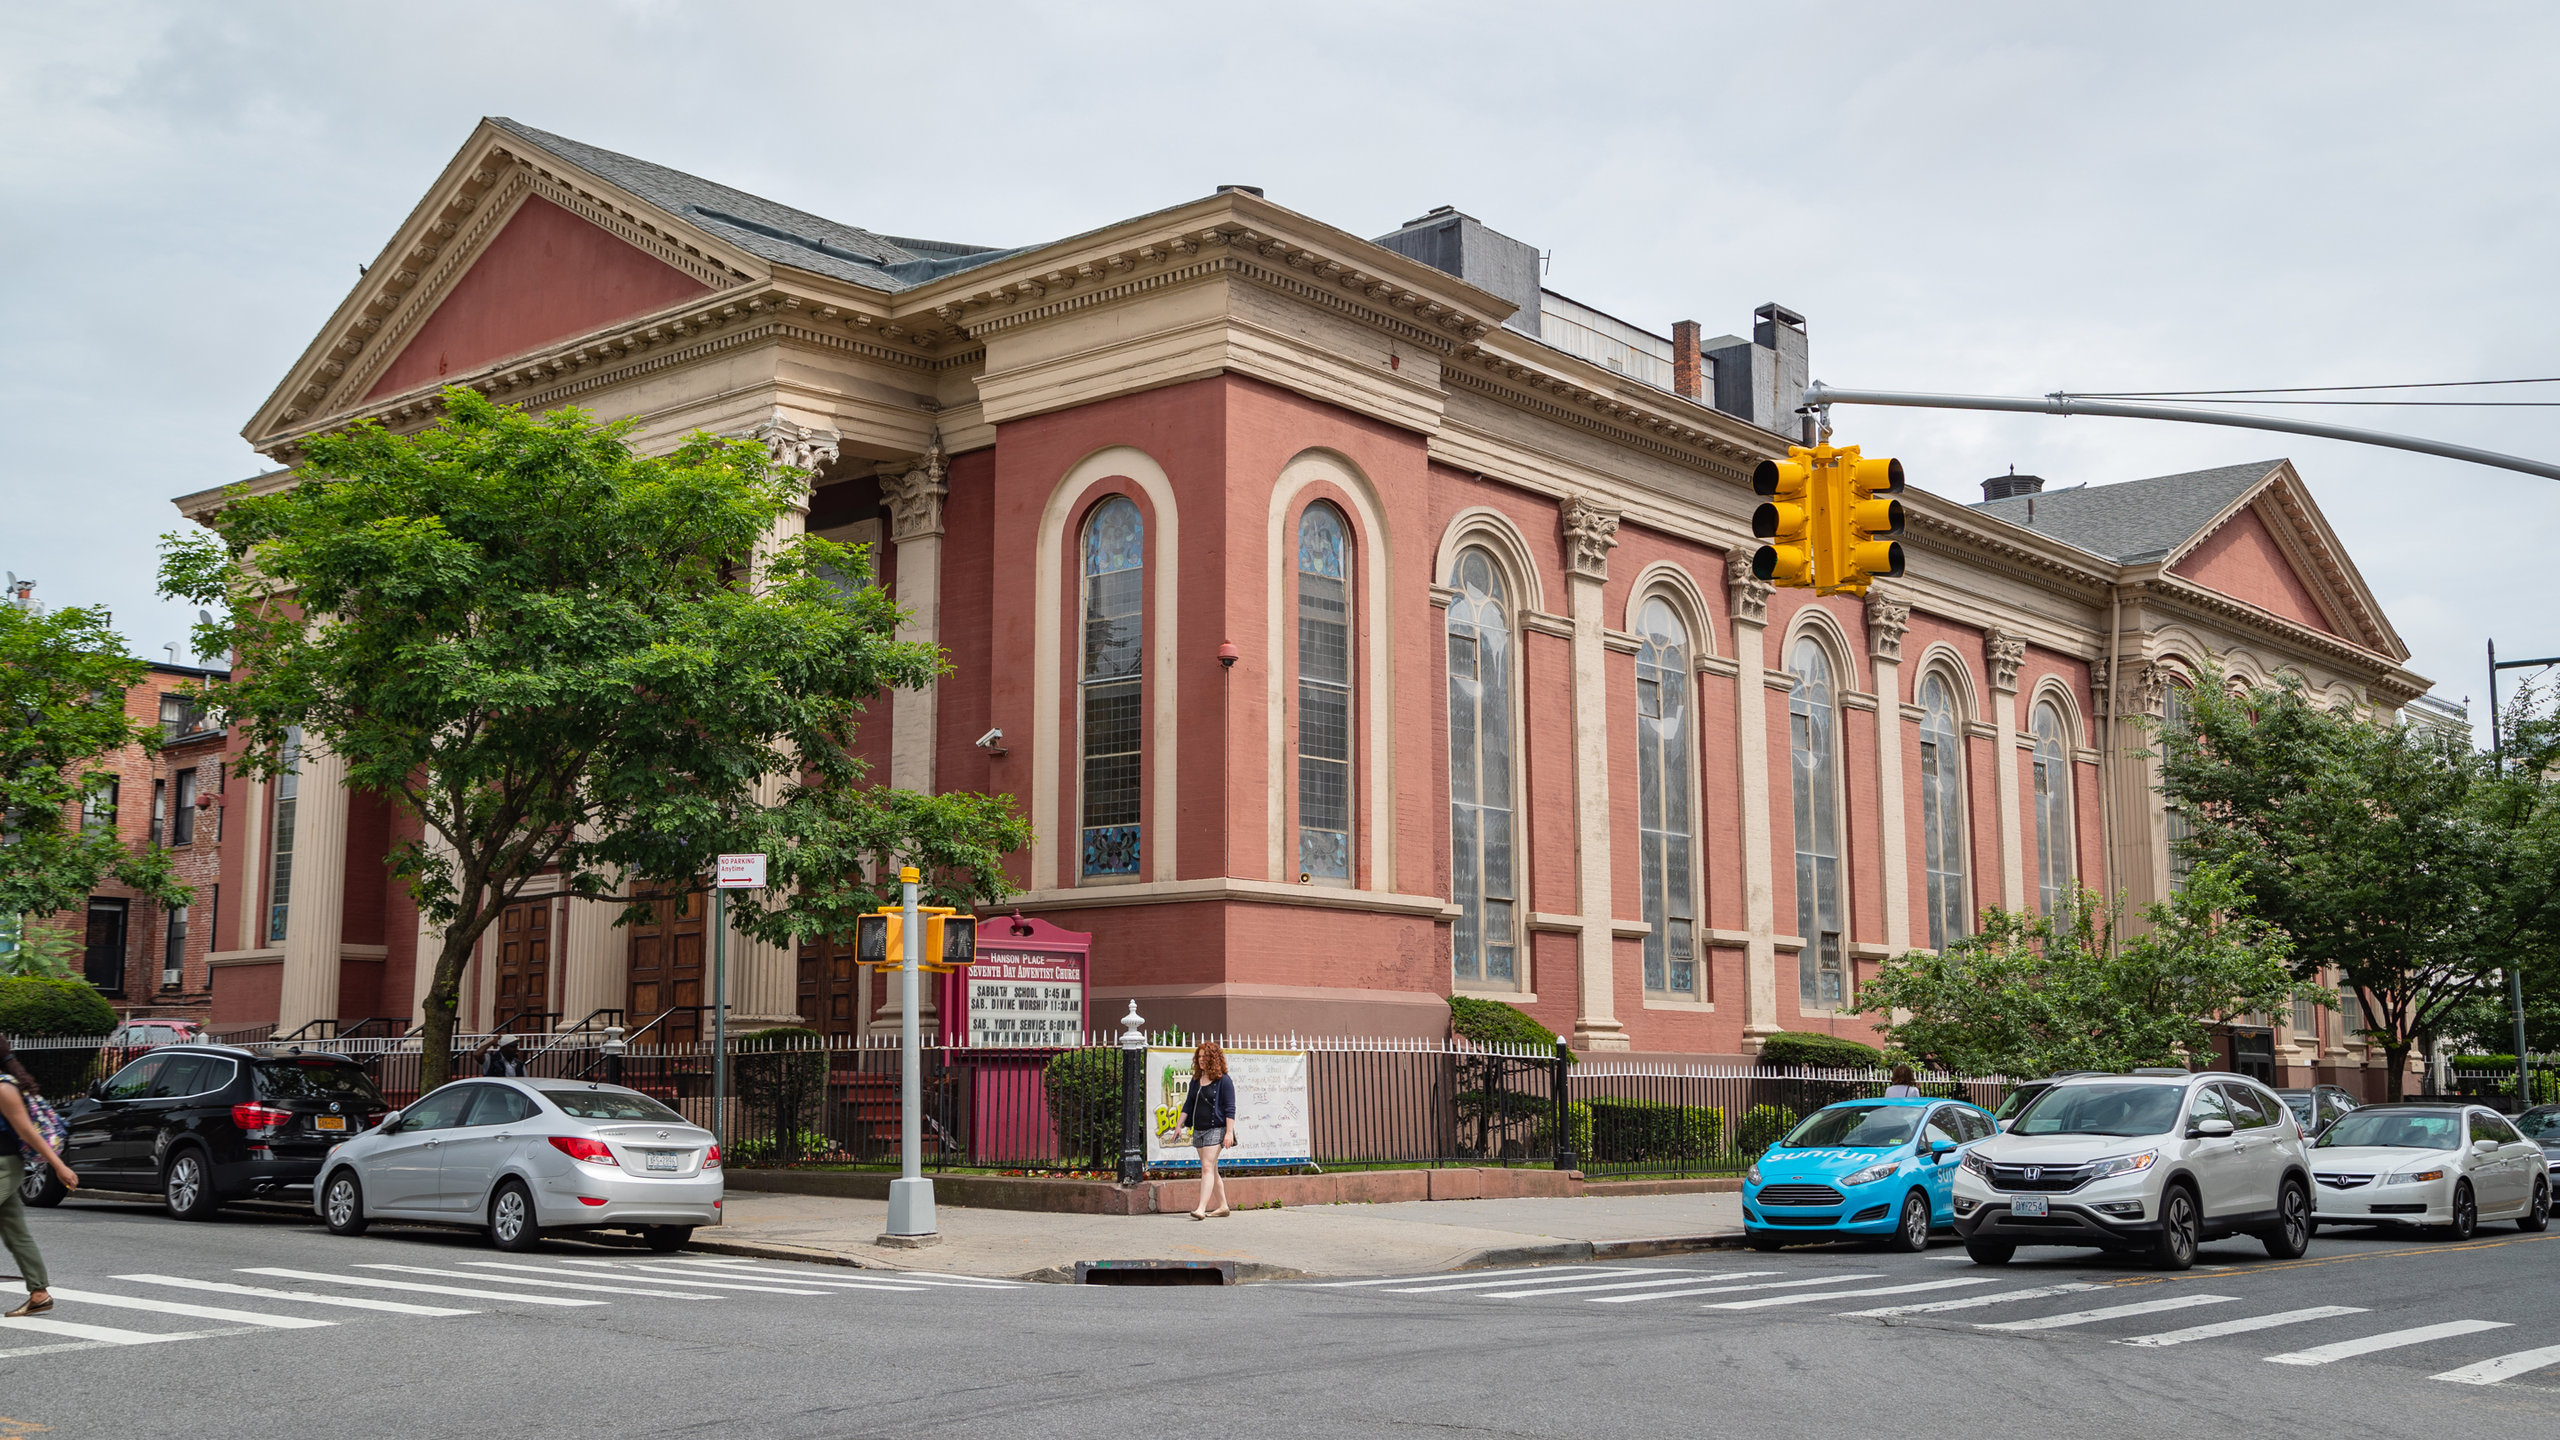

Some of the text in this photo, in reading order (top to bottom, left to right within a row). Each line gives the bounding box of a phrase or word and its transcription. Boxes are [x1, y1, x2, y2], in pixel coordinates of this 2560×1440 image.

[990, 953, 1045, 965] HANSON PLACE
[968, 965, 1080, 980] SEVENTH DAY ADVENTIST CHURCH
[977, 986, 1071, 999] SABBATH SCHOOL 9:45 AM
[971, 999, 1079, 1012] SAB. DIVINE WORSHIP 11:30 AM
[972, 1018, 1077, 1031] SAB. YOUTH SERVICE 6:00 PM
[1766, 1150, 1878, 1163] sunrun
